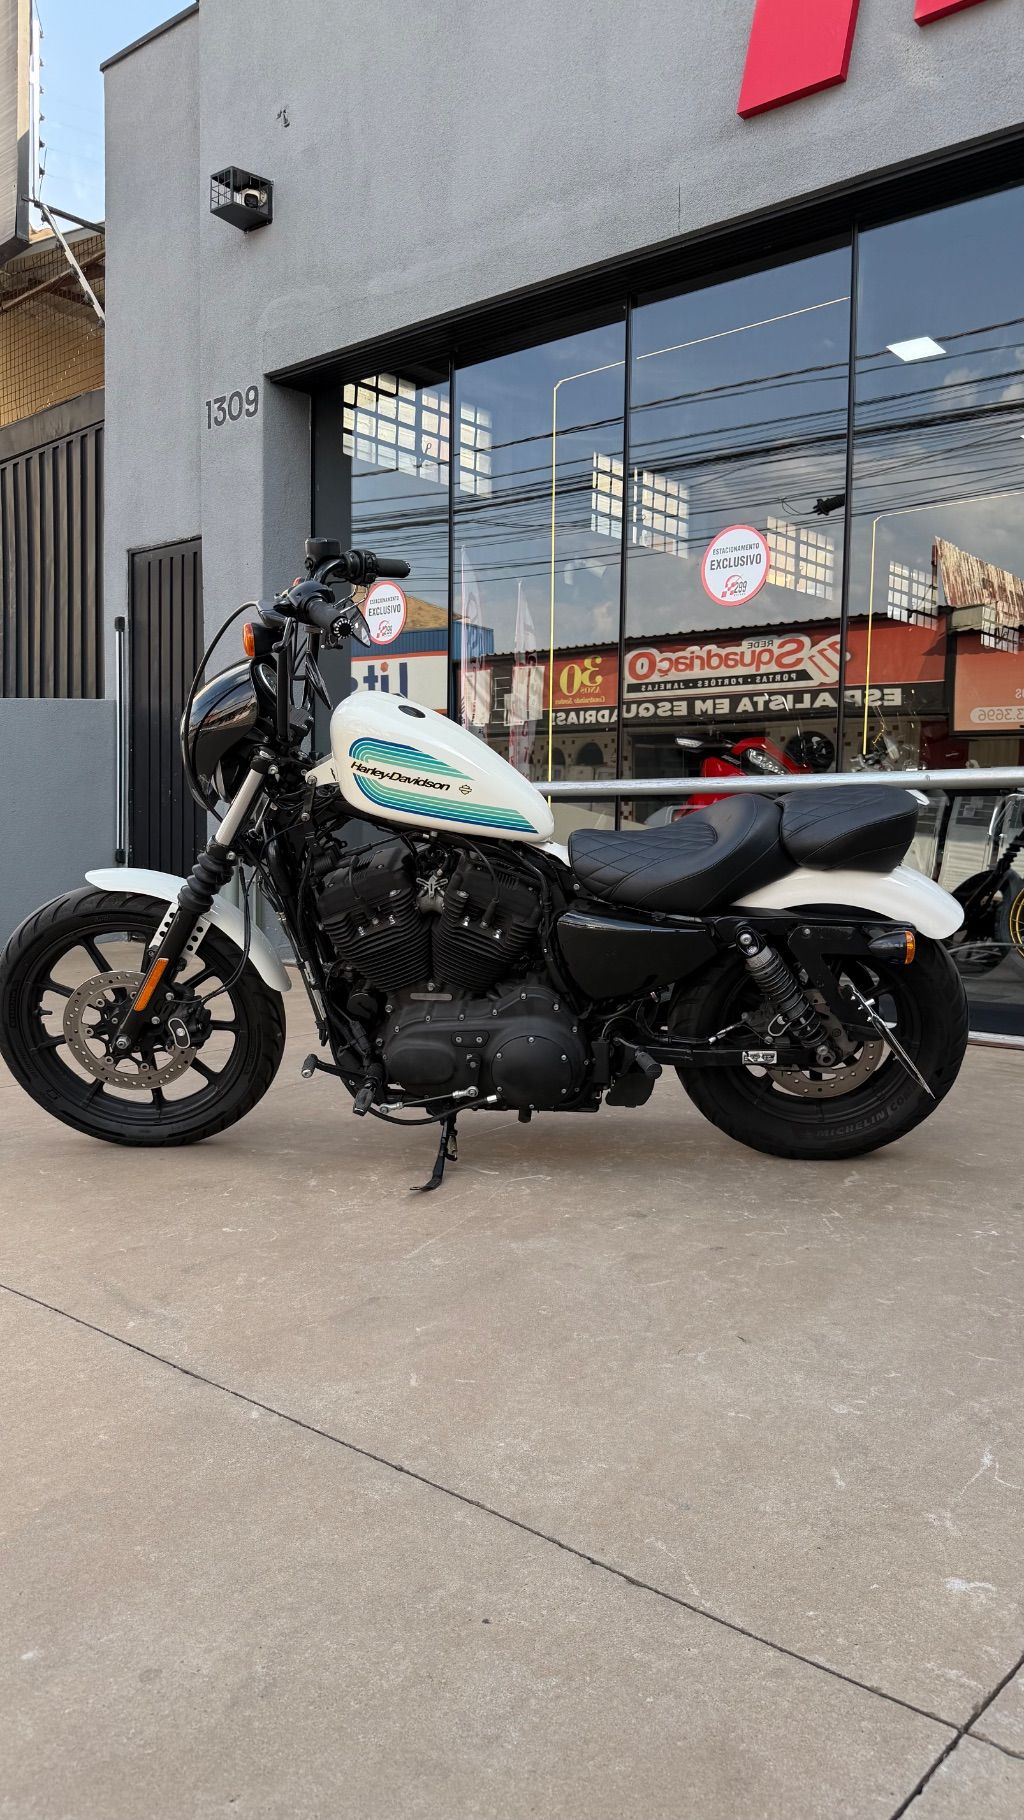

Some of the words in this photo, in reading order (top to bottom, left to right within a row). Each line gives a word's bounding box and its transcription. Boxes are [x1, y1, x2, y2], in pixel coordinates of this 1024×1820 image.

[206, 385, 259, 430] 1309
[712, 543, 760, 555] ESTACIONAMENTO
[710, 553, 762, 571] EXCLUSIVO
[368, 603, 402, 617] EXCLUSIVO
[351, 761, 450, 791] Harley-Davidson
[816, 1109, 886, 1137] MICHELIN
